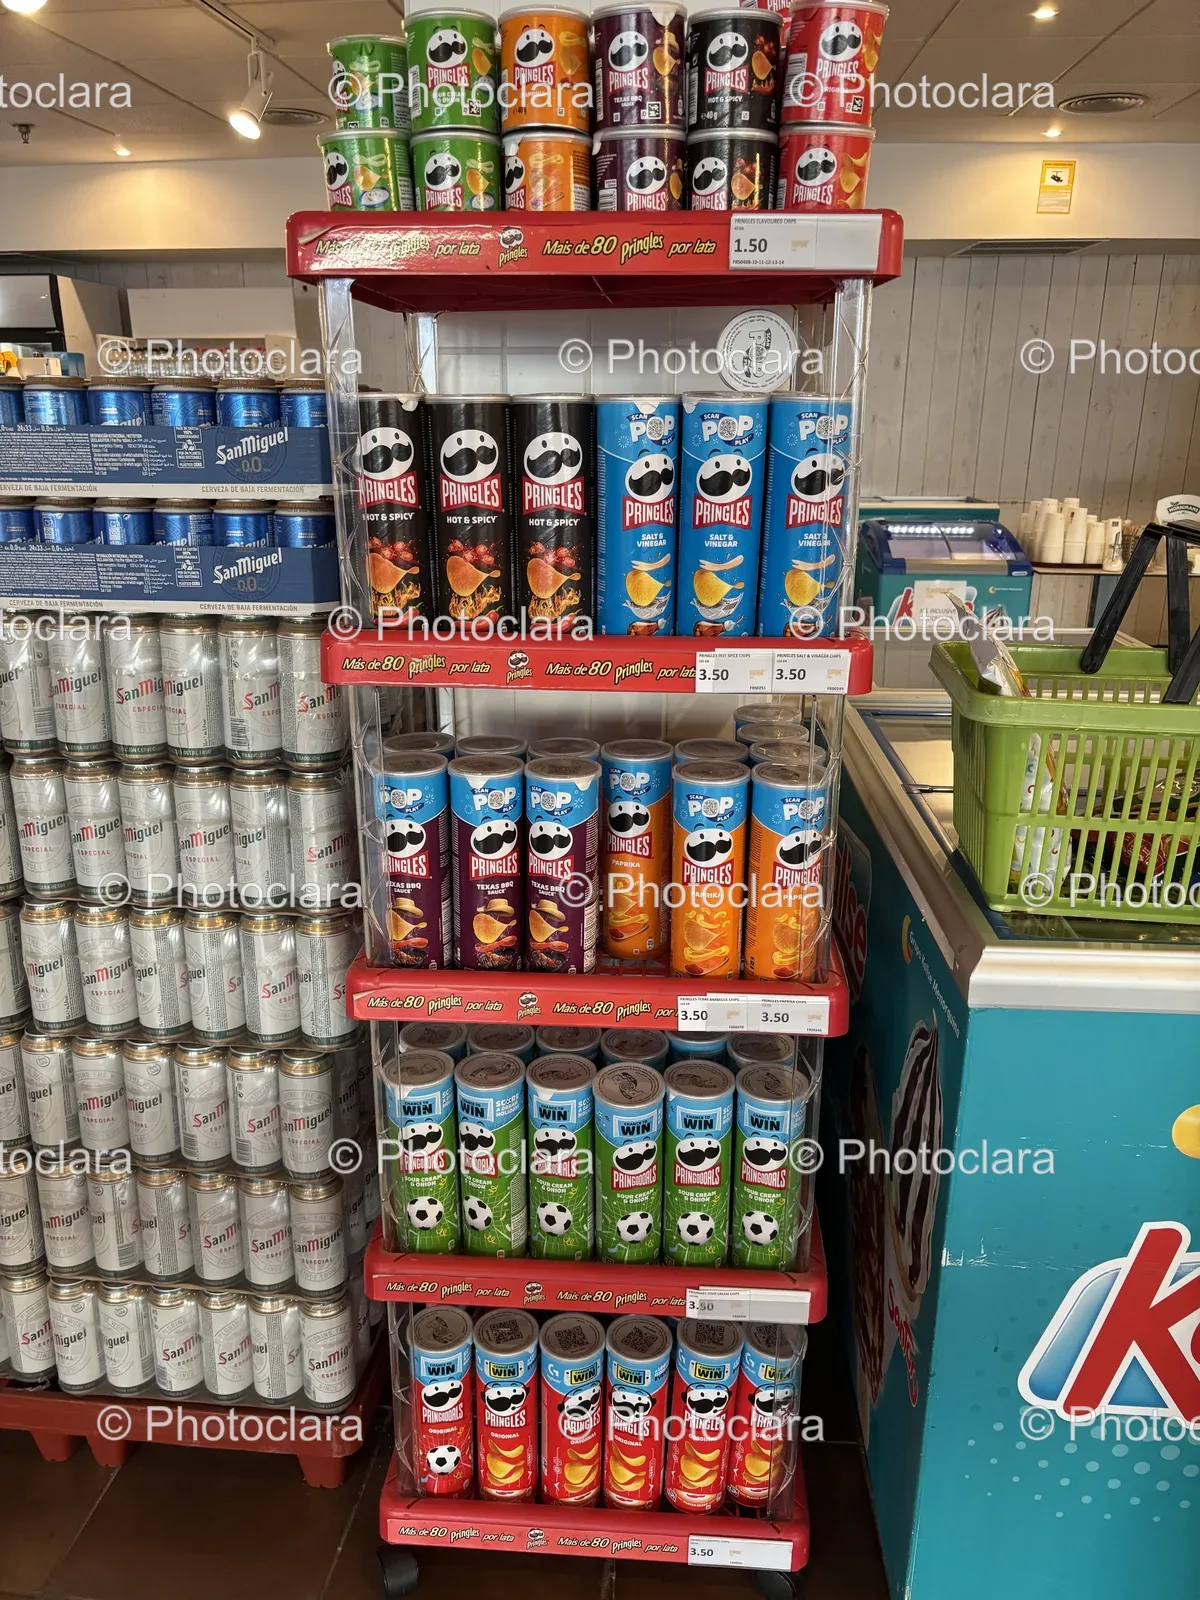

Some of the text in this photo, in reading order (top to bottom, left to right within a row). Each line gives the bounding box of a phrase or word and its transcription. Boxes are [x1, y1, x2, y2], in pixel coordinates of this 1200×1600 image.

[610, 69, 648, 91] PRINGLES
[706, 69, 746, 91] PRINGLES
[793, 184, 833, 205] PRINGLES
[434, 244, 457, 258] por
[459, 240, 480, 254] lata
[543, 240, 572, 254] Mais
[620, 232, 664, 264] Pringles
[668, 244, 691, 257] por
[693, 240, 716, 254] lata
[734, 238, 768, 253] 1.50
[499, 247, 528, 268] Pringles
[257, 485, 304, 493] FERMENTACIÓN
[442, 476, 500, 508] PRINGLES
[525, 480, 582, 511] PRINGLES
[625, 496, 674, 526] PRINGLES
[696, 495, 750, 526] PRINGLES
[447, 516, 462, 524] HOT
[464, 516, 470, 524] &
[343, 657, 365, 670] Más
[409, 654, 446, 678] Pringles
[449, 662, 470, 674] por
[471, 662, 490, 673] lata
[546, 662, 573, 675] Mais
[614, 658, 654, 684] Pringles
[657, 667, 678, 680] por
[699, 669, 729, 680] 3.50
[776, 669, 806, 680] 3.50
[506, 667, 532, 684] Pringles
[608, 834, 650, 858] PRINGLES
[471, 852, 518, 880] PRINGLES
[611, 860, 640, 868] PAPRIKA
[92, 988, 125, 996] ESPECIAL
[368, 996, 390, 1008] Más
[428, 994, 462, 1016] Pringles
[464, 1002, 484, 1013] por
[485, 1001, 503, 1012] lata
[517, 1006, 541, 1021] Pringles
[553, 1002, 578, 1013] Mais
[616, 1000, 651, 1022] Pringles
[654, 1008, 674, 1019] por
[681, 1010, 708, 1020] 3.50
[761, 1012, 789, 1023] 3.50
[684, 1118, 713, 1130] WIN
[302, 1257, 333, 1265] ESPECIAL
[688, 1301, 714, 1311] 3.50
[492, 1368, 515, 1377] WIN
[485, 1409, 526, 1428] PRINGLES
[399, 1526, 418, 1536] Más
[450, 1528, 480, 1543] Pringles
[482, 1534, 498, 1542] por
[500, 1533, 515, 1542] lata
[690, 1548, 714, 1556] 3.50
